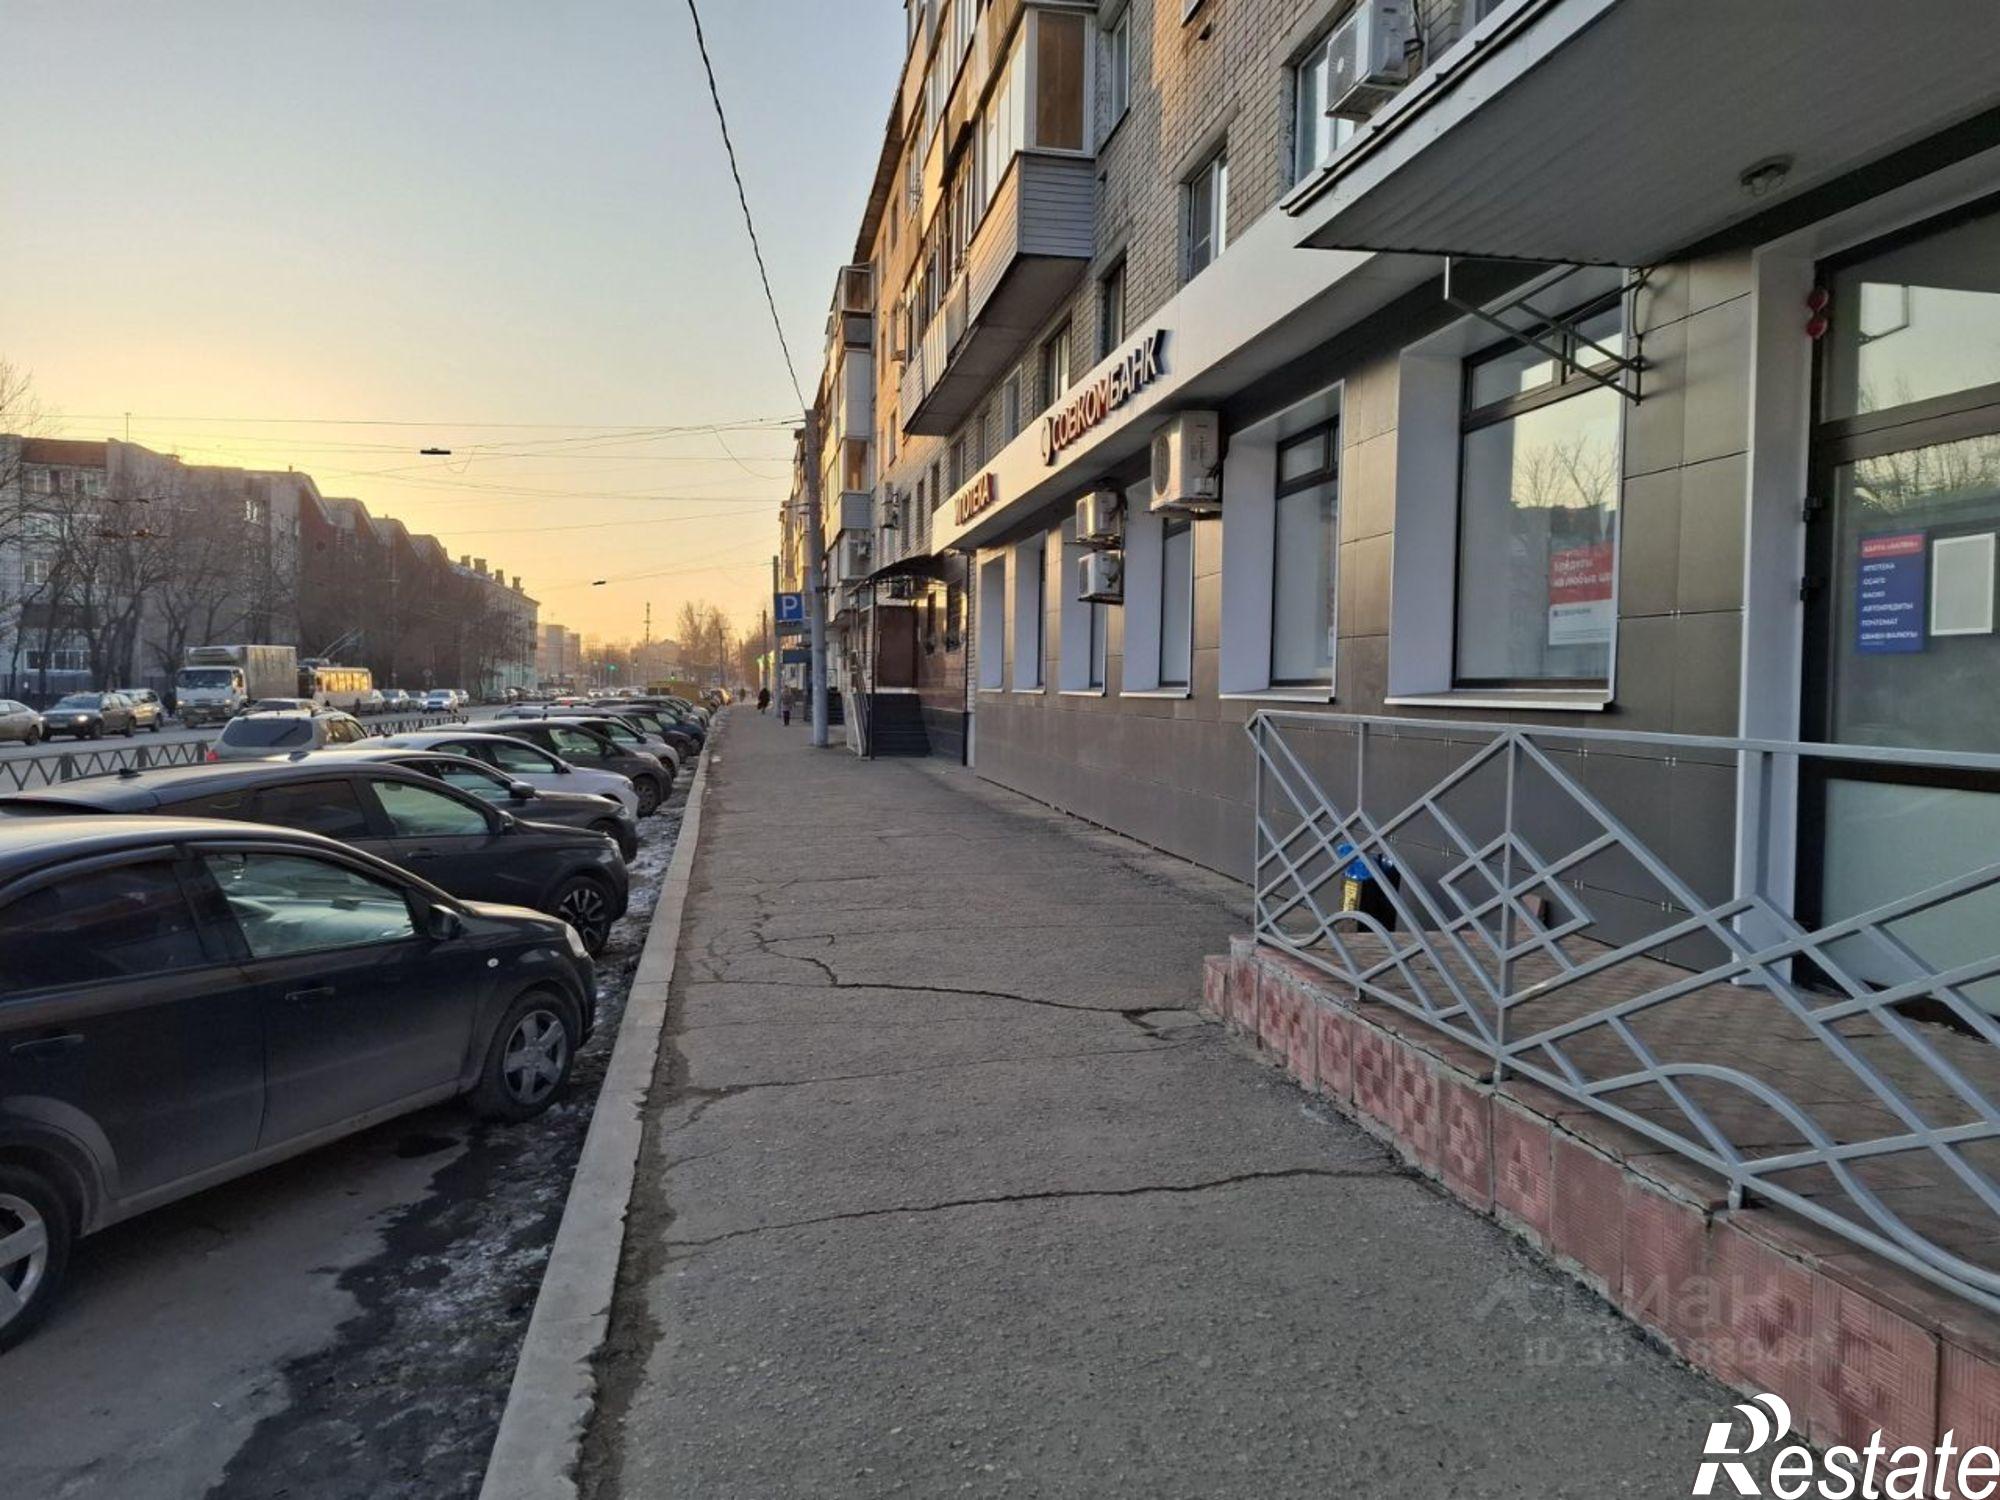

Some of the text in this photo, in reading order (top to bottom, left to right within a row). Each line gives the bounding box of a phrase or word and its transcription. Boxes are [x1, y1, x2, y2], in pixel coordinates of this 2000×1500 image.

[1052, 329, 1164, 451] СОВКОМБАНК
[1863, 562, 1896, 572] ИПОТЕКА
[781, 595, 798, 618] P
[1862, 603, 1913, 612] АВТОКРЕДИТЫ
